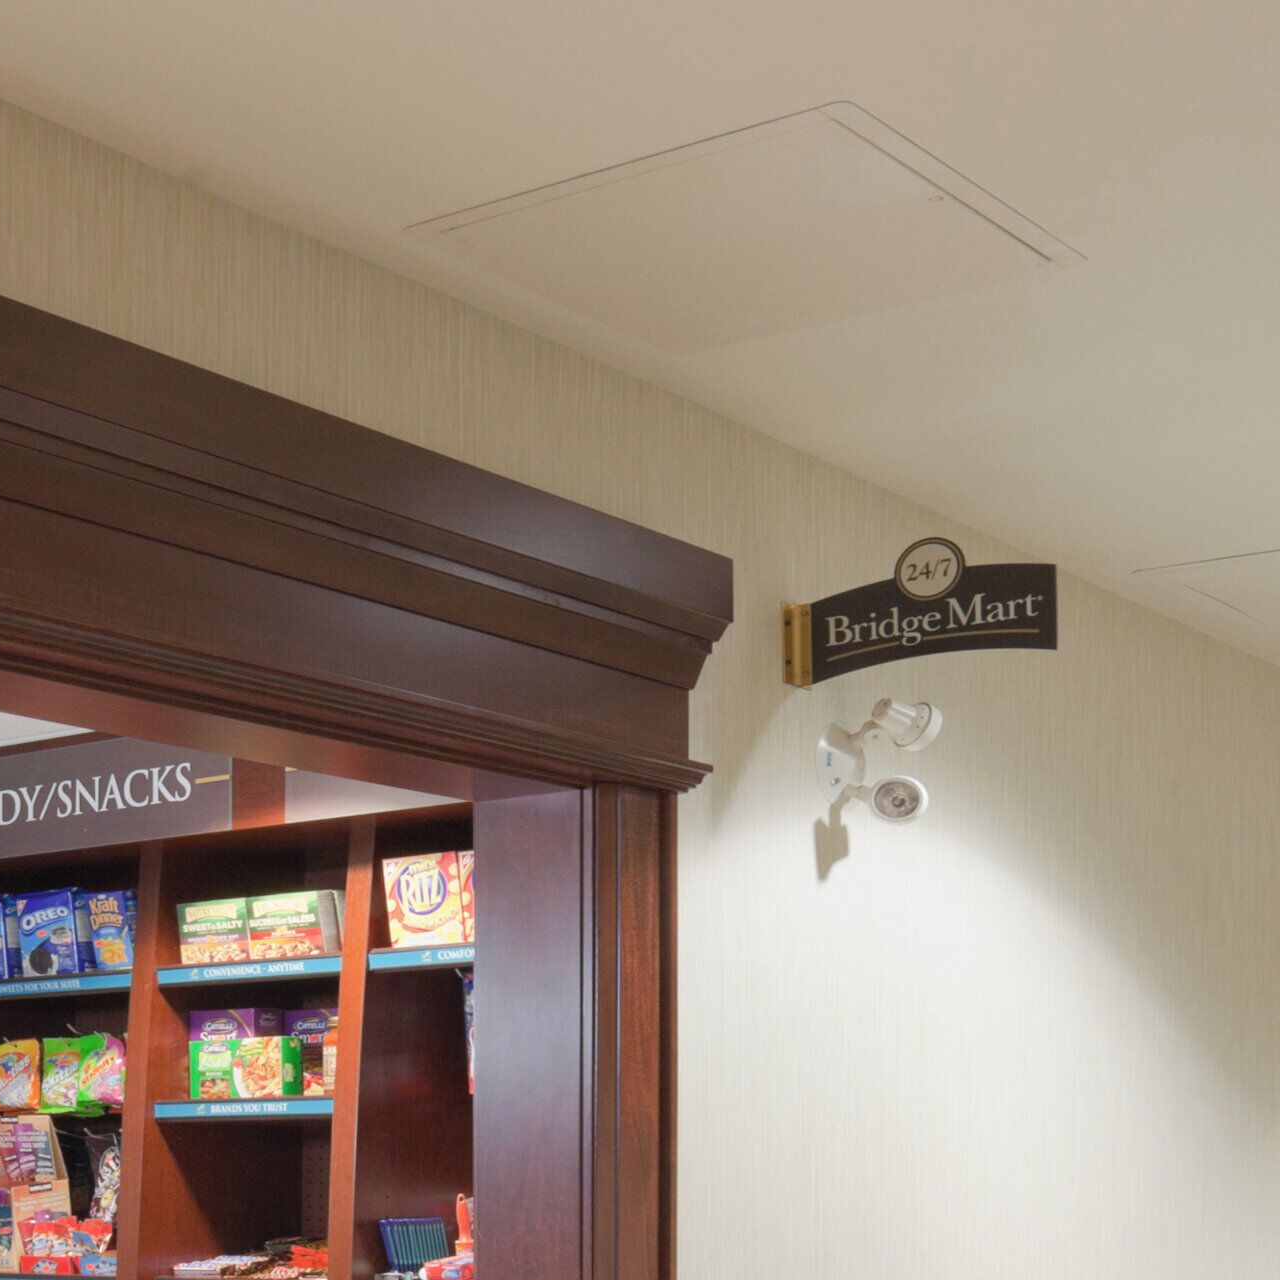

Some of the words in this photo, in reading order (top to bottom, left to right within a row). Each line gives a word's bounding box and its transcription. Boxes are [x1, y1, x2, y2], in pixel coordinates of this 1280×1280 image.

[906, 558, 952, 582] 24/7
[89, 896, 119, 914] Kraft
[22, 906, 68, 931] OREO
[90, 913, 124, 930] Dinner
[204, 965, 261, 978] CONVENIENCE
[267, 962, 305, 972] ANYTIME
[25, 983, 39, 992] FOR
[210, 1104, 242, 1114] BRANDS
[243, 1104, 262, 1113] YOU
[263, 1103, 288, 1112] TRUST
